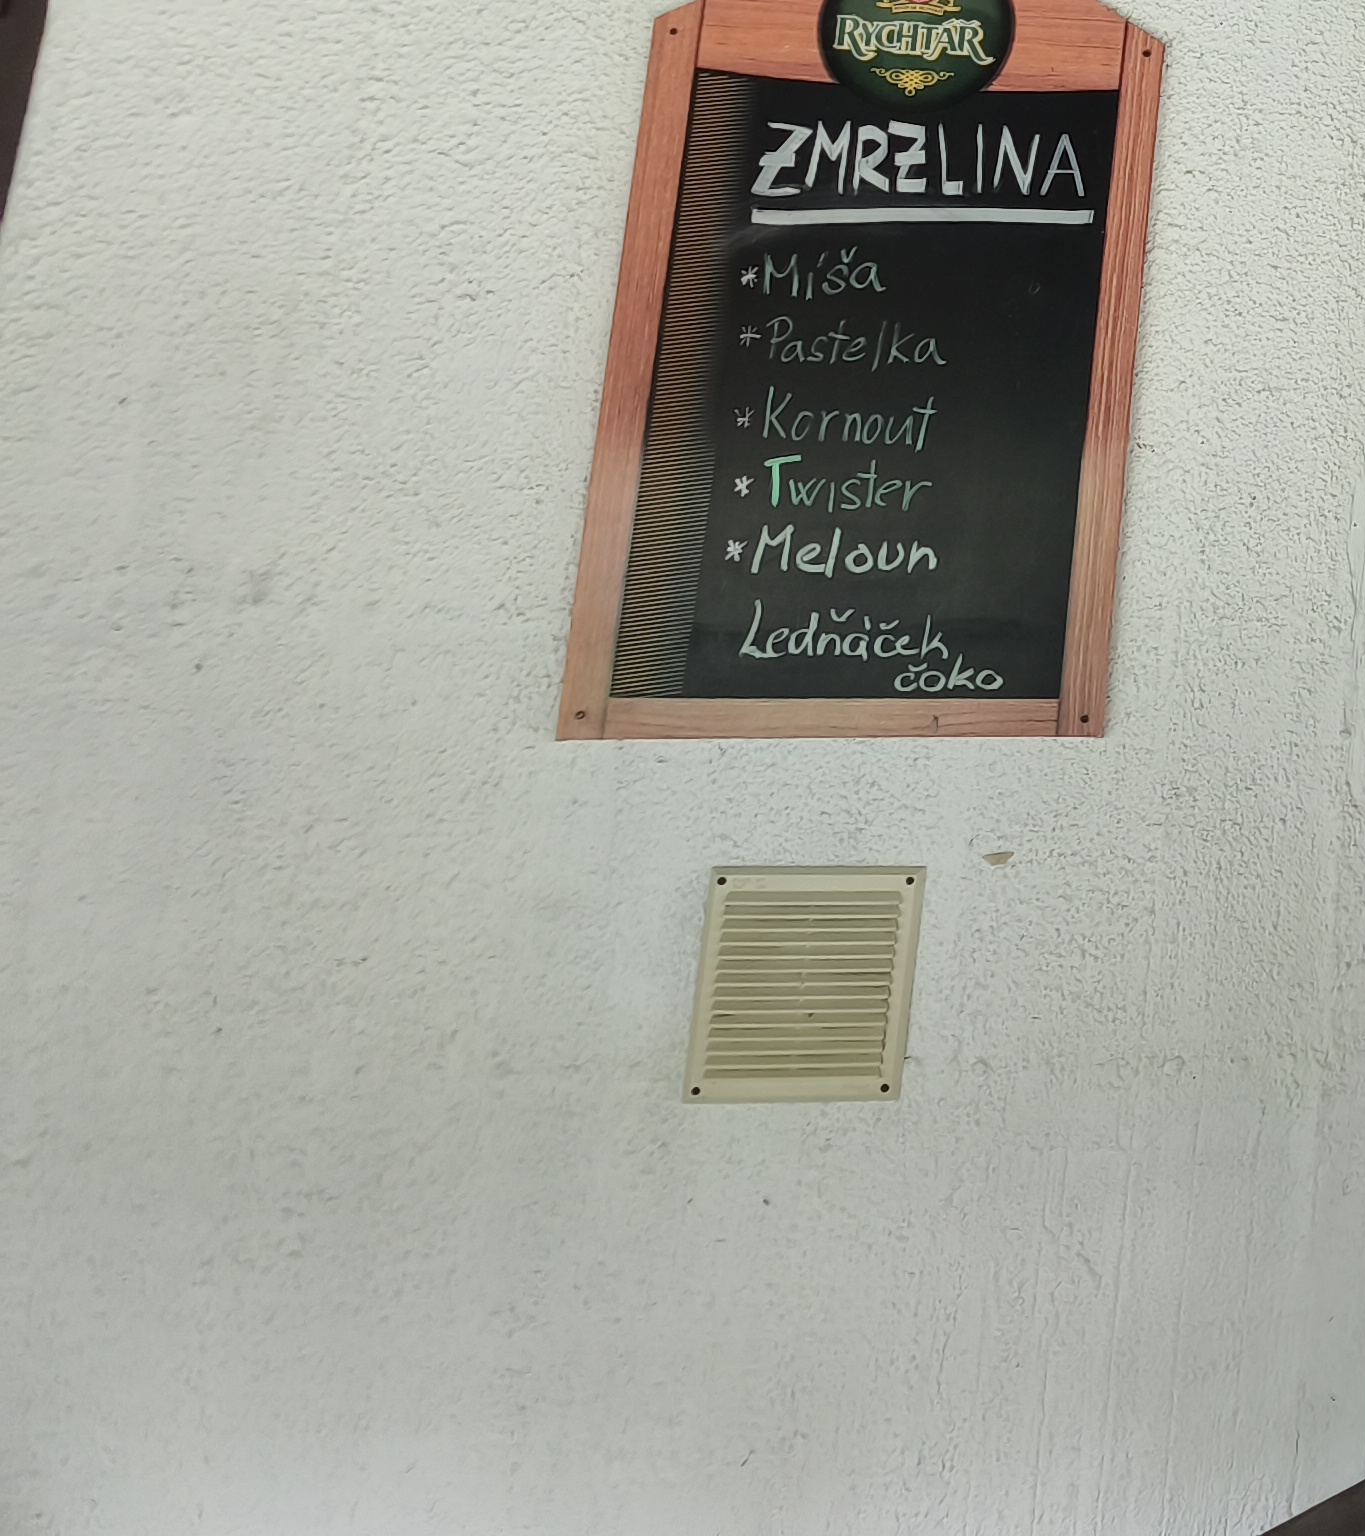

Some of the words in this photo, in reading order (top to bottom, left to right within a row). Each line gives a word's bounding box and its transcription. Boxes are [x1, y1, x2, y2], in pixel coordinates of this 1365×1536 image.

[833, 15, 996, 62] RYCHTÁŘ
[751, 120, 1085, 197] ZMRZLINA
[739, 599, 949, 661] Ledňáček
[894, 654, 1004, 693] čoko
